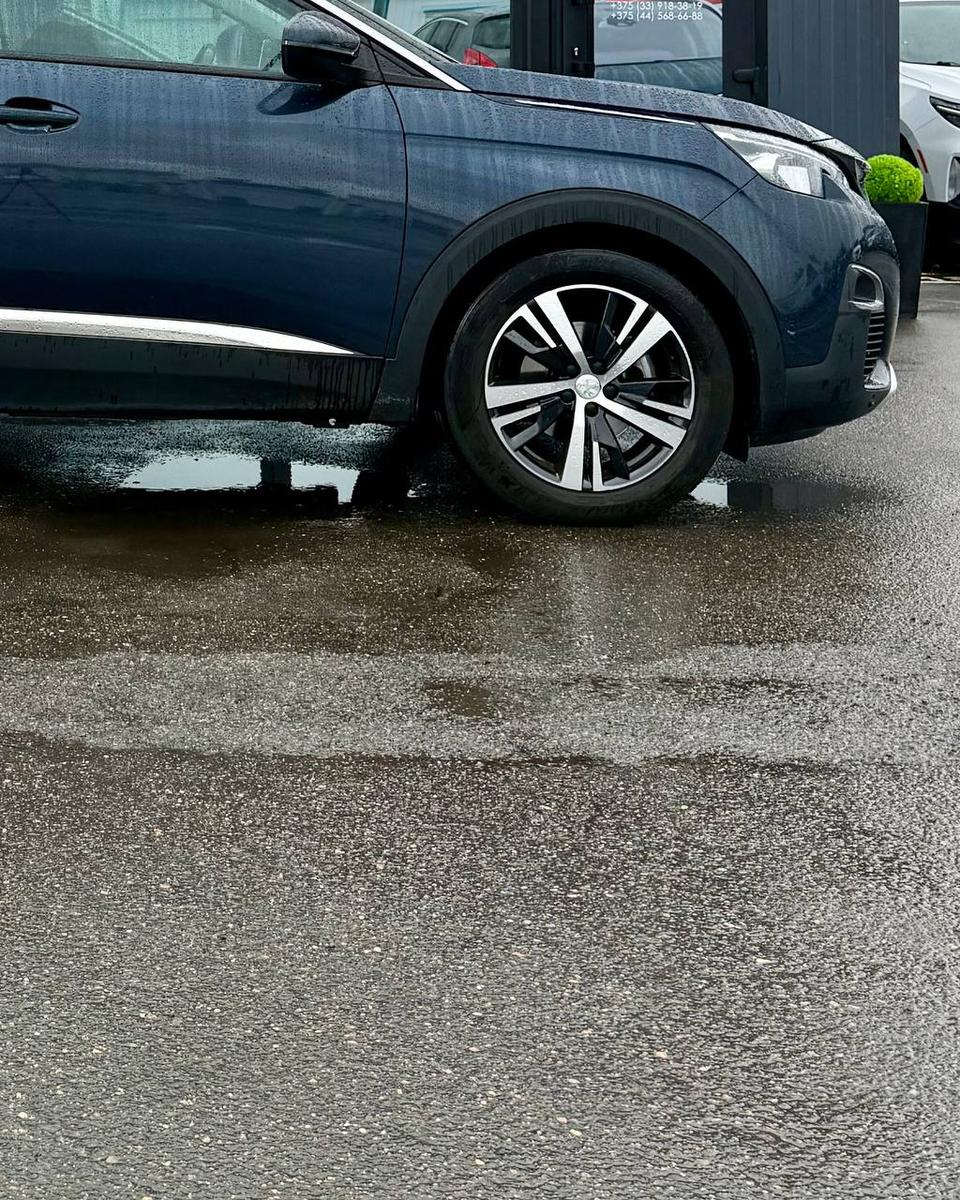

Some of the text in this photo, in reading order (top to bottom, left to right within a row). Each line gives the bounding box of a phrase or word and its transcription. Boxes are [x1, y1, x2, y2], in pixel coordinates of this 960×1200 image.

[611, 1, 703, 12] +375 (33) 918-38-19
[611, 11, 703, 22] +375 (44) 568-66-88
